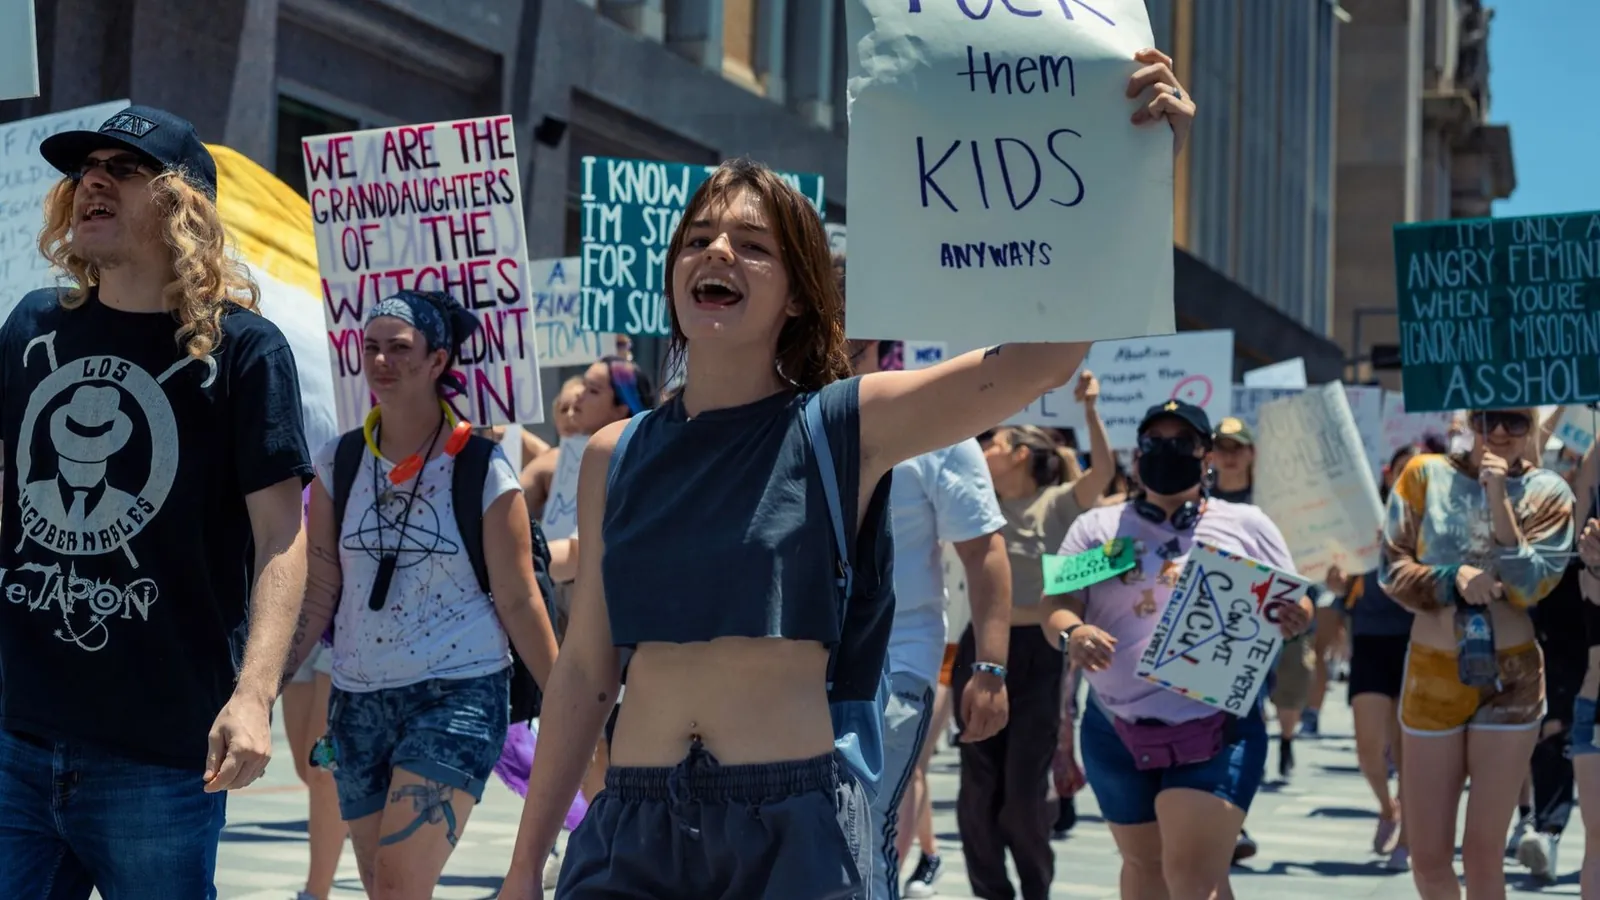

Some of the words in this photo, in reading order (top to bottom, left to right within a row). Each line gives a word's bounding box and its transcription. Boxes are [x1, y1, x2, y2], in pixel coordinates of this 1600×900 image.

[957, 45, 1075, 97] them
[303, 136, 357, 181] WE
[382, 125, 441, 174] ARE
[453, 117, 515, 164] THE
[916, 128, 1085, 213] KIDS
[311, 168, 514, 224] GRANDDAUGHTERS
[581, 156, 597, 201] I
[607, 160, 690, 206] KNOW
[341, 224, 380, 271] OF
[420, 212, 496, 262] THE
[582, 203, 623, 243] I'M
[1456, 221, 1495, 248] I'M
[1512, 216, 1569, 244] ONLY
[584, 243, 637, 288] FOR
[940, 240, 1052, 269] ANYWAYS
[1408, 249, 1495, 290] ANGRY
[581, 287, 615, 332] I'M
[1412, 289, 1489, 318] WHEN
[1507, 282, 1586, 314] YOU'RE
[328, 330, 364, 377] YO
[1402, 318, 1495, 367] IGNORANT
[83, 358, 131, 381] LOS
[1443, 357, 1600, 408] ASSHOL
[1211, 631, 1235, 666] MI
[1247, 638, 1276, 664] TE
[1224, 664, 1260, 710] METAS
